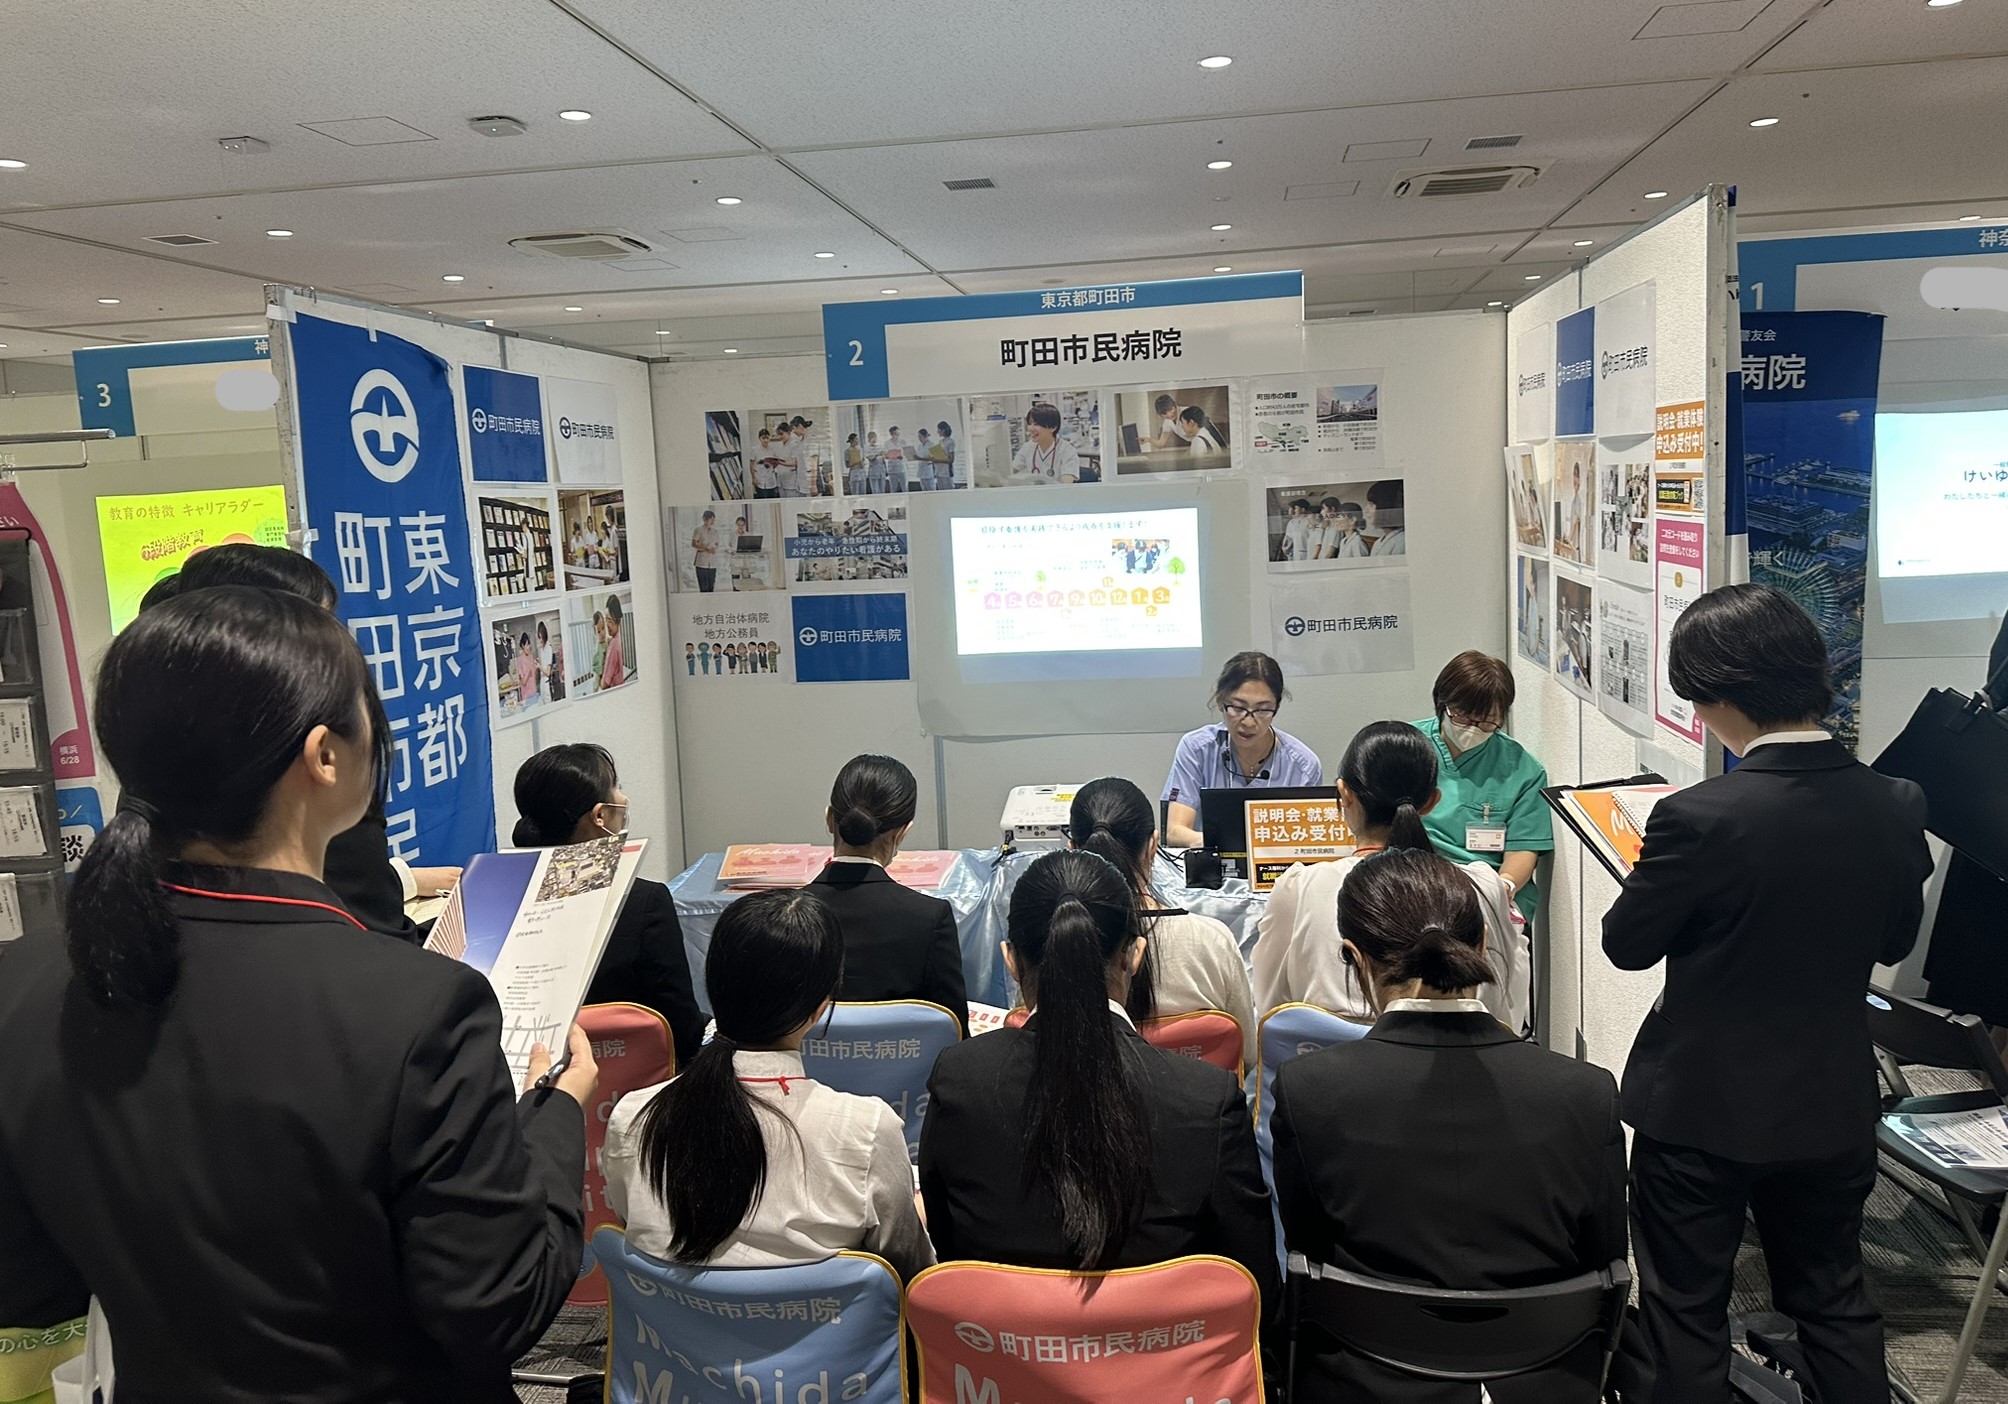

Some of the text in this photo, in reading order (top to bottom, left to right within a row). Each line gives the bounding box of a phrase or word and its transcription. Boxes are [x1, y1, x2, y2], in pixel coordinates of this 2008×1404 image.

[1041, 287, 1136, 308] 東京都町田市
[1751, 282, 1764, 310] 1
[848, 340, 863, 366] 2
[1000, 328, 1183, 368] 町田市民病院
[96, 383, 112, 408] 3
[487, 414, 541, 436] 町田市民病院
[571, 422, 615, 440] 町田市民病院
[109, 498, 265, 521] 教育の特徴 キャリアラダー
[791, 546, 901, 558] あなたのやりたい看護がある
[1748, 551, 1783, 567] 輝く
[692, 613, 770, 626] 地方自治体病院
[1307, 615, 1398, 633] 町田市民病院
[704, 627, 759, 640] 地方公務員
[819, 629, 902, 643] 町田市民病院
[398, 509, 468, 789] 東京都
[60, 756, 80, 765] 6/28
[1253, 807, 1344, 824] 説明会・就業
[661, 1286, 842, 1325] 町田市民病院
[0, 1322, 88, 1354] の心を大
[998, 1319, 1206, 1364] 町田市民病院
[634, 1312, 868, 1404] Machida
